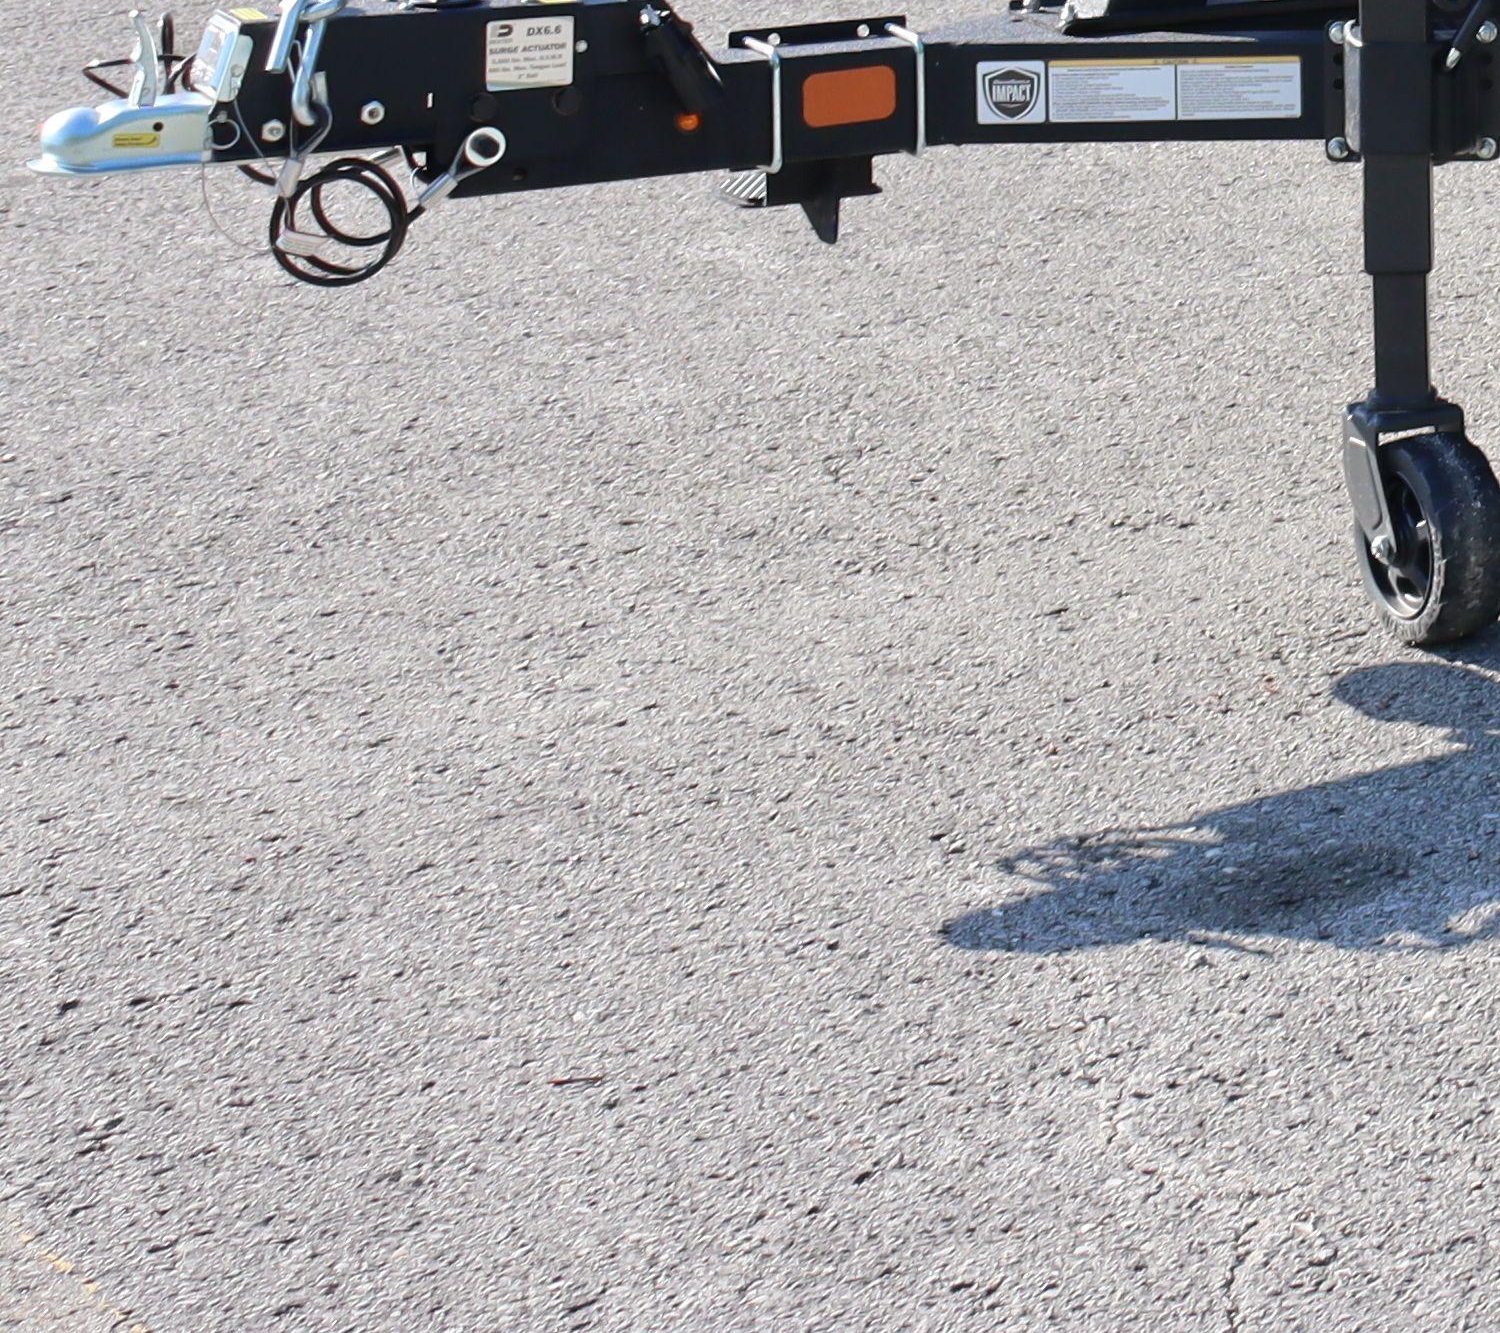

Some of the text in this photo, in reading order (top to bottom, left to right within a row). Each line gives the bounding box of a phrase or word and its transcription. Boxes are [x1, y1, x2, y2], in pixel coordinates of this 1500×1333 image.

[526, 24, 563, 37] DX6.6
[488, 42, 567, 55] SURGE ACTUATOR
[991, 83, 1032, 102] IMPACT
